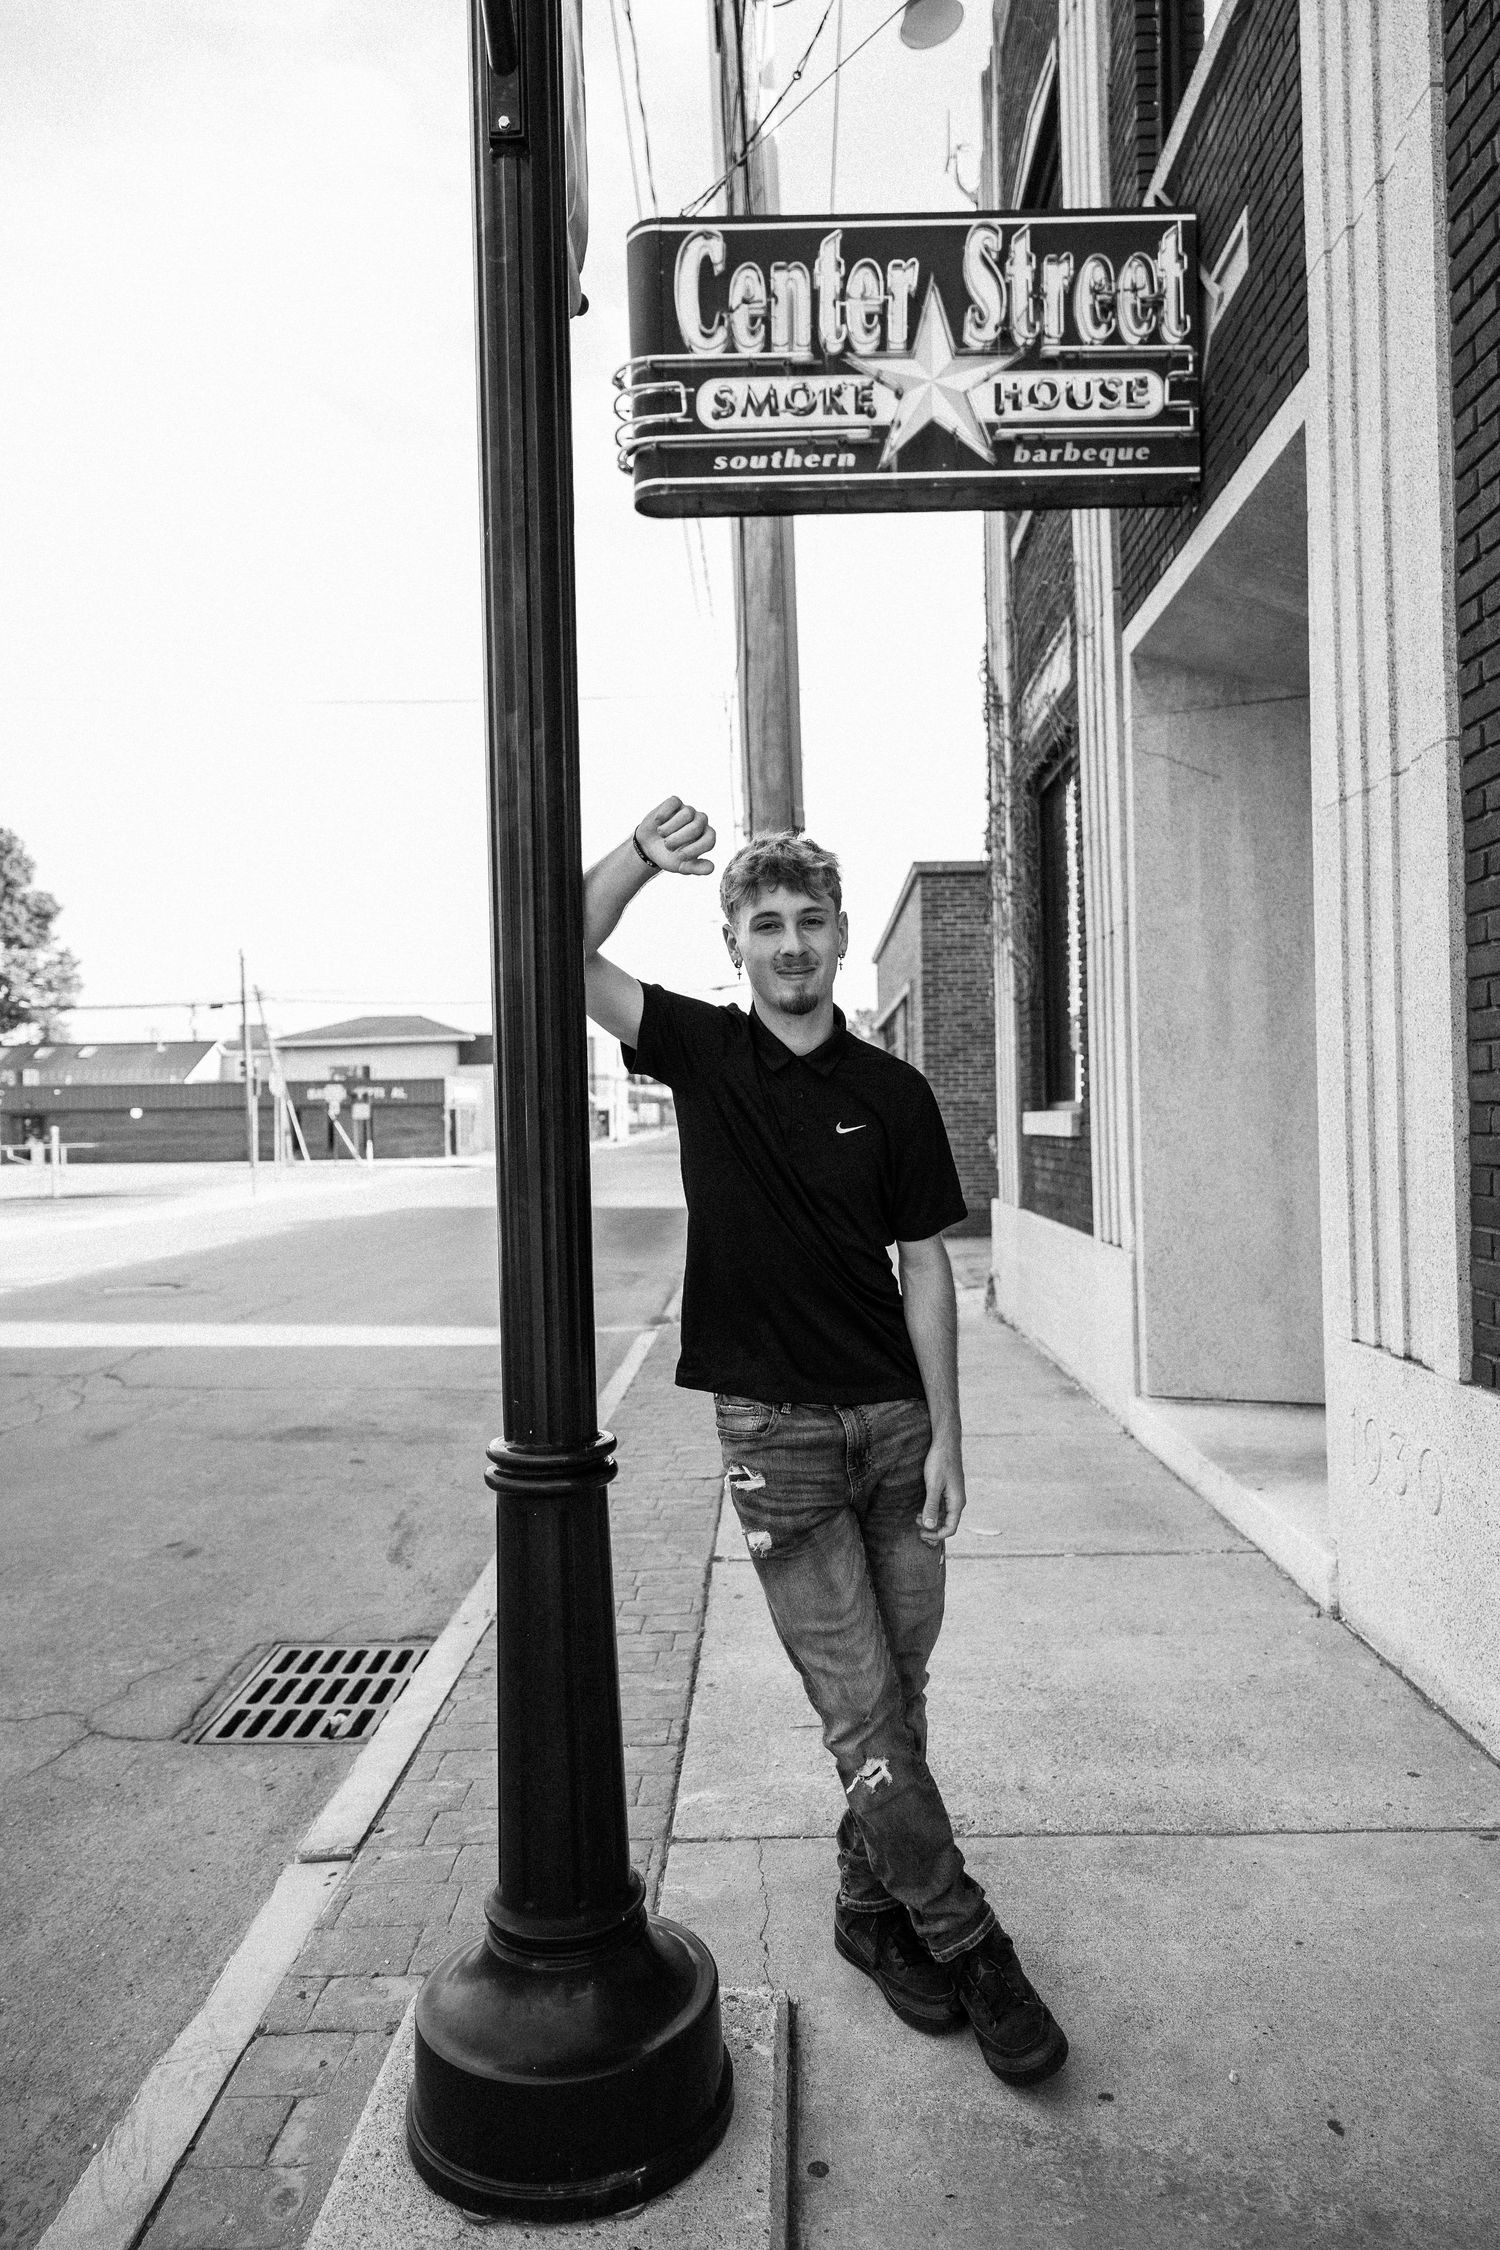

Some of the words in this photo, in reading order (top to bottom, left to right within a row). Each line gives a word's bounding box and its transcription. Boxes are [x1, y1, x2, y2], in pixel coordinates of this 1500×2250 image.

[674, 228, 920, 354] Center
[963, 221, 1191, 349] Street
[711, 383, 877, 420] SMOKE
[994, 377, 1150, 415] HOUSE
[713, 448, 856, 470] southern
[1013, 441, 1150, 467] barbeque
